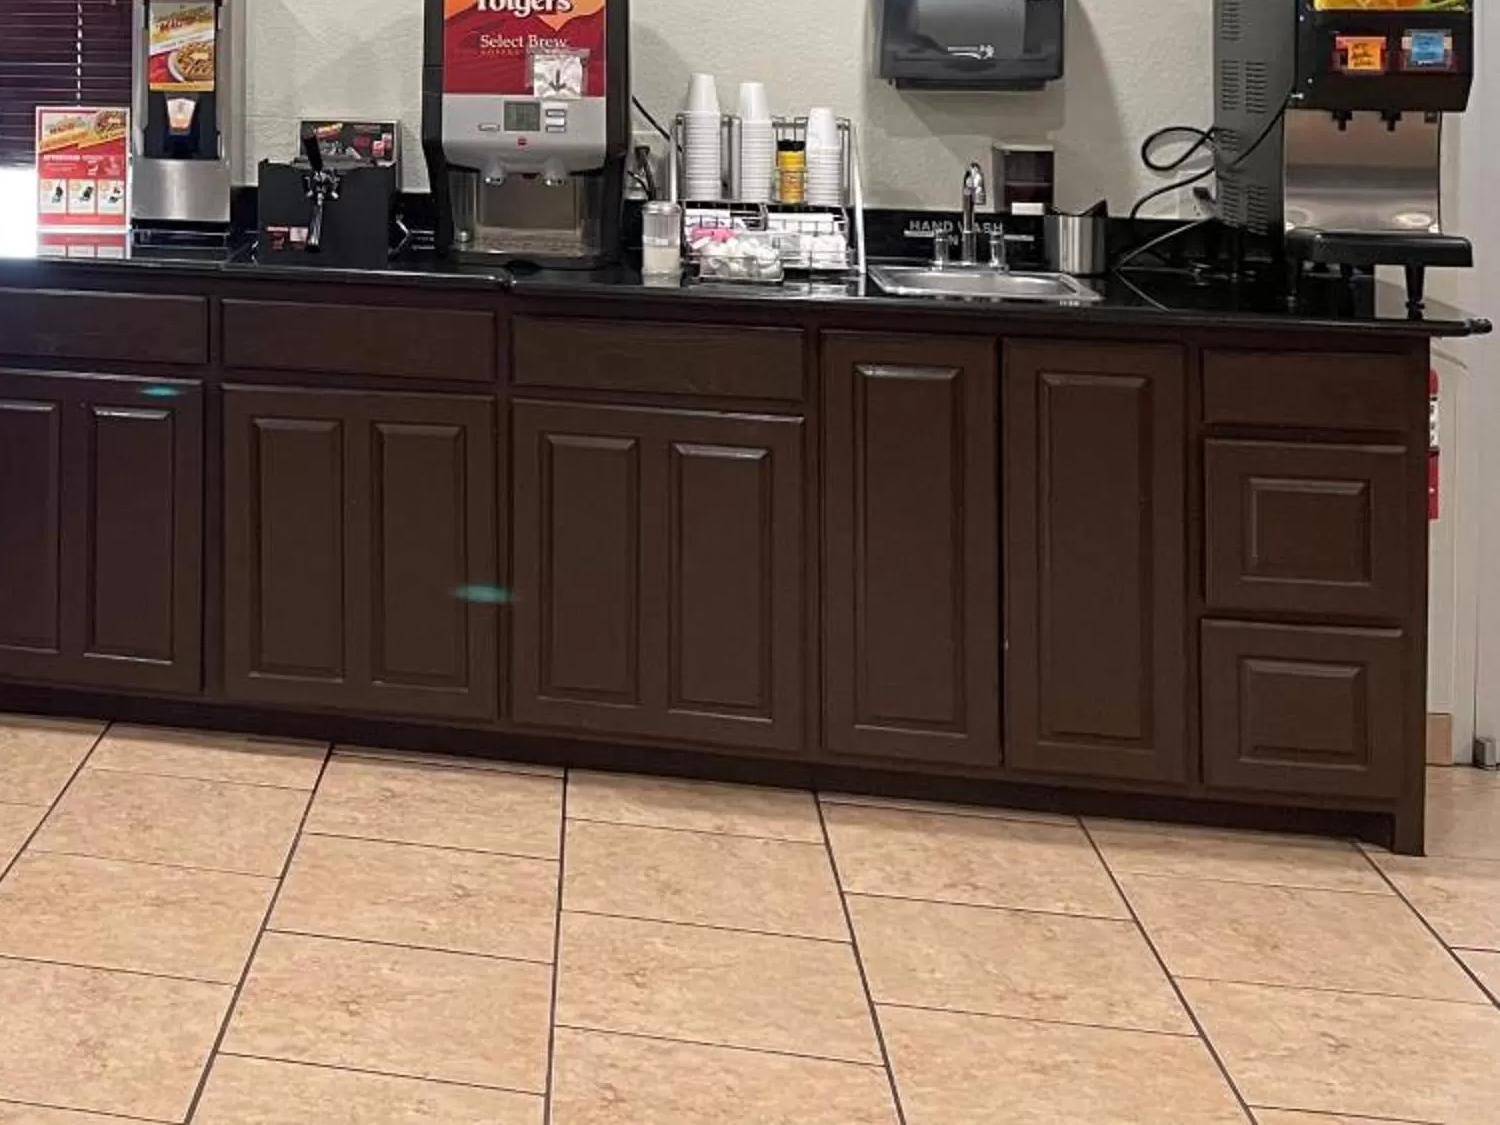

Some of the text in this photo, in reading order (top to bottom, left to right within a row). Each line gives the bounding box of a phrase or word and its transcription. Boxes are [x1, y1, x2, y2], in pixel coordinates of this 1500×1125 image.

[480, 34, 568, 48] Select Brew
[908, 219, 954, 233] HAND
